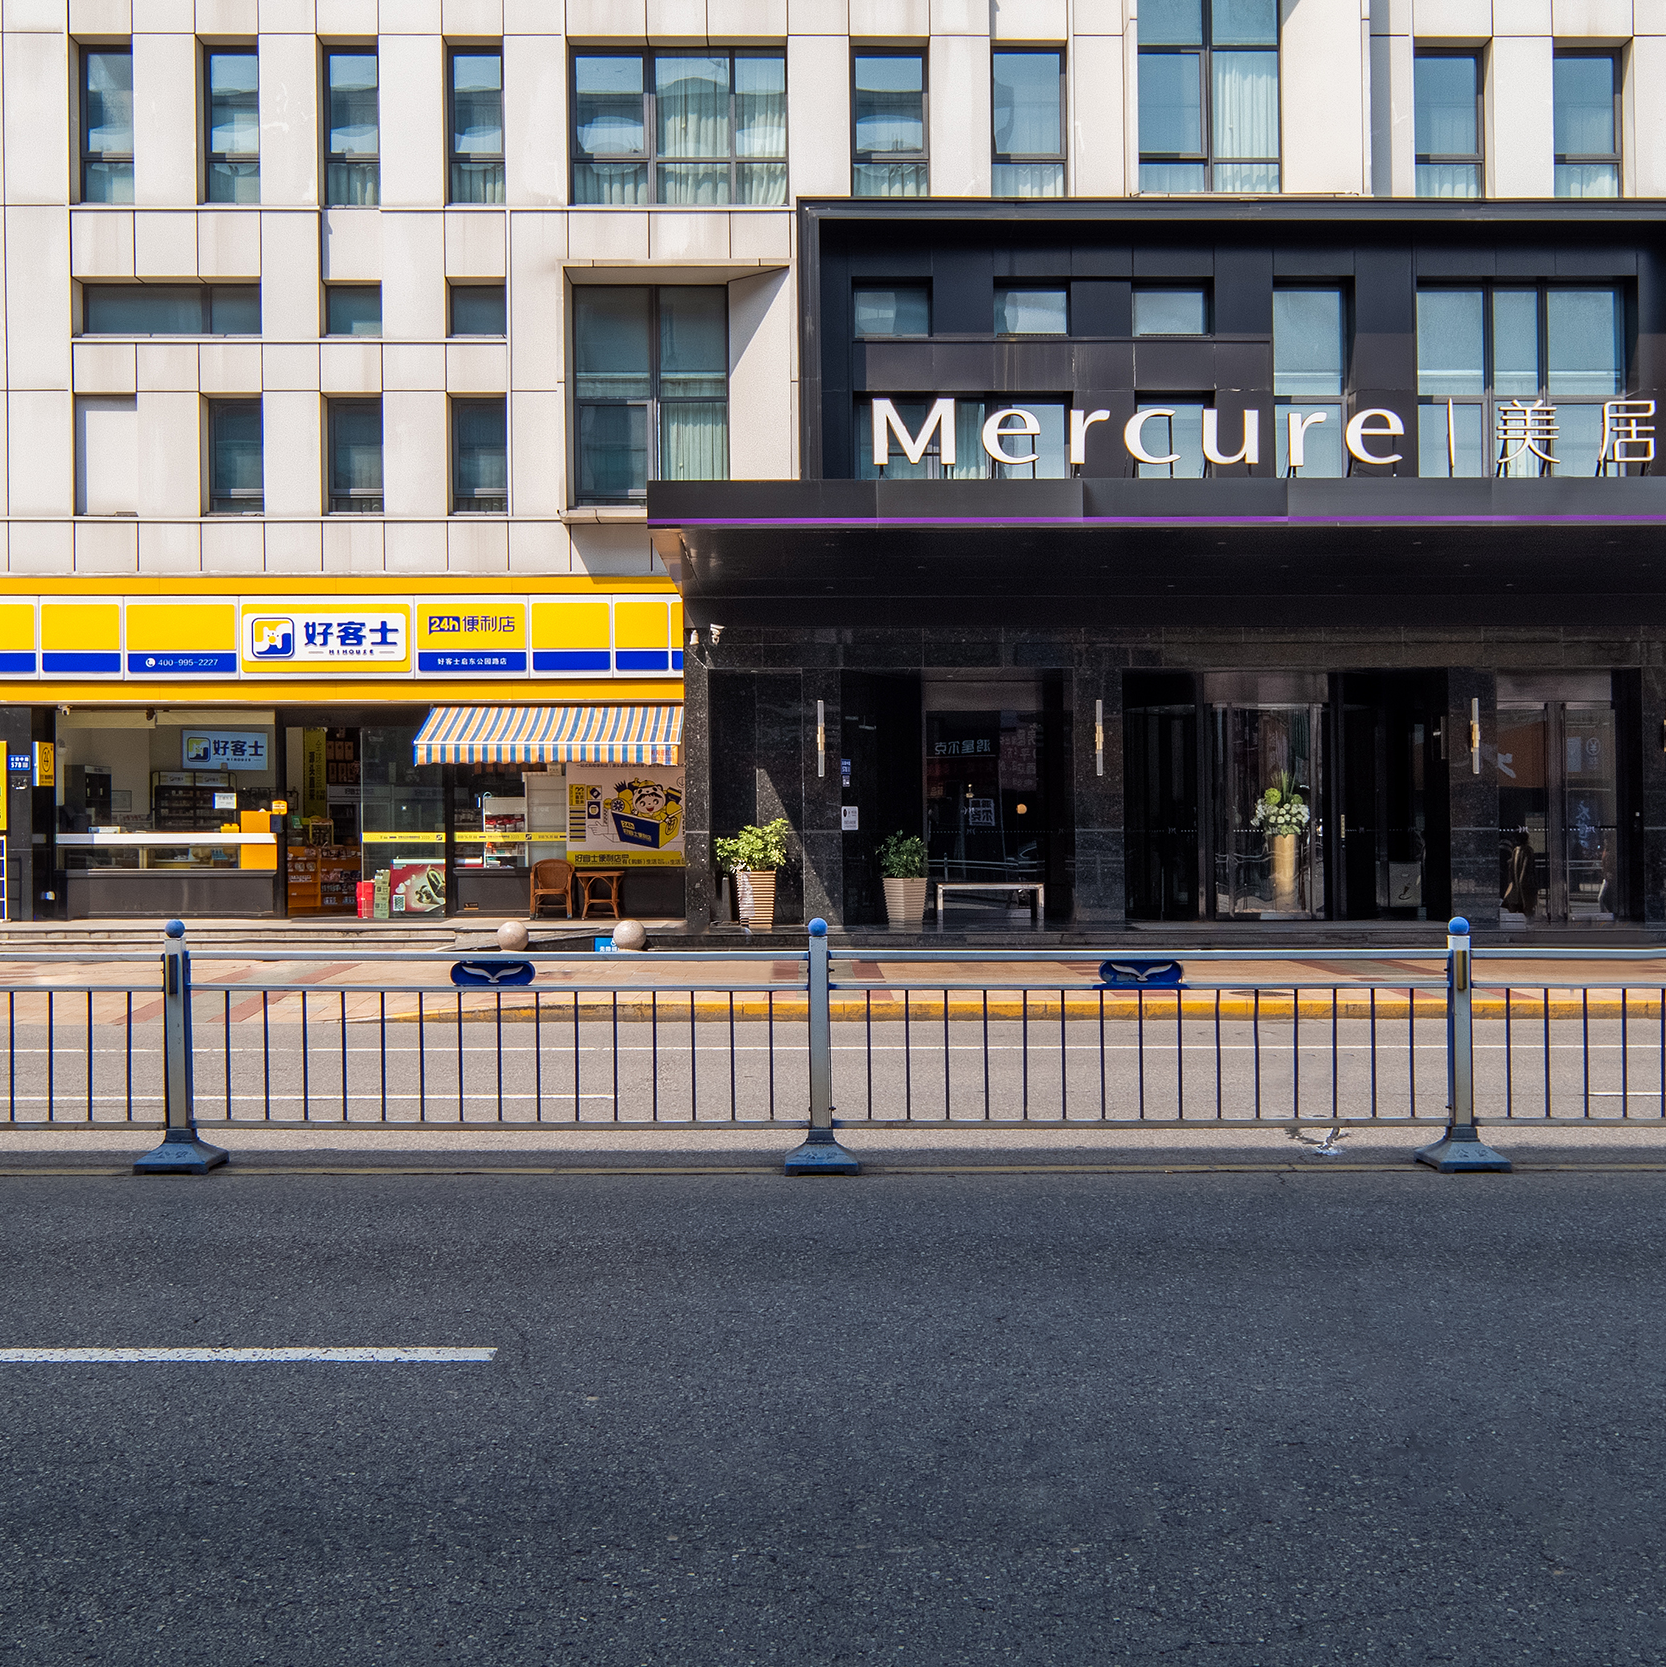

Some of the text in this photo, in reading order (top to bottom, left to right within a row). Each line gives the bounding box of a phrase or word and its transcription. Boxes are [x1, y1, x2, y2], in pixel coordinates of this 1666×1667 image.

[872, 397, 1405, 466] Mercure
[431, 616, 515, 632] 24h 便利店
[304, 621, 399, 647] 好客士
[158, 658, 219, 667] 400-995-2227
[213, 740, 265, 757] 好客士
